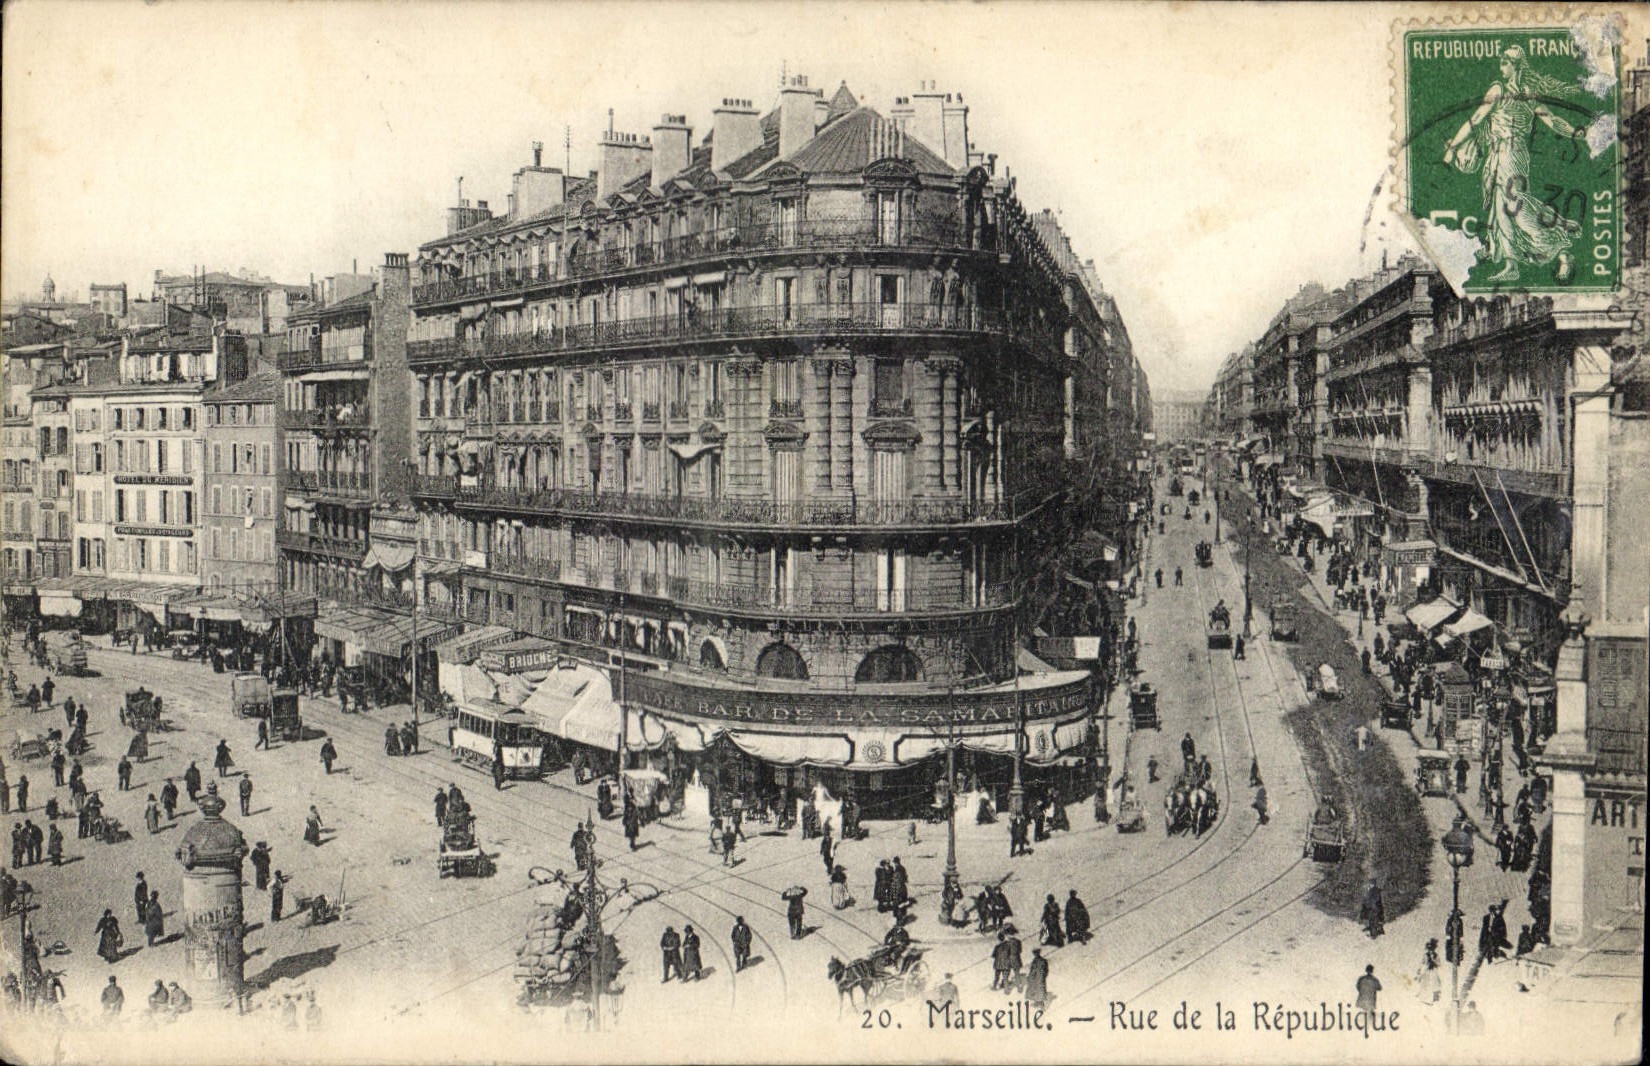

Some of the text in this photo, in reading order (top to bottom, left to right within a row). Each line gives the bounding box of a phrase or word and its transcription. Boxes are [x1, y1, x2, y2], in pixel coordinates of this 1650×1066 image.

[1413, 40, 1501, 60] REPUBLIQUE
[1593, 190, 1612, 276] POSTES
[698, 702, 751, 719] BAR
[772, 707, 814, 721] DE
[835, 709, 881, 722] LA
